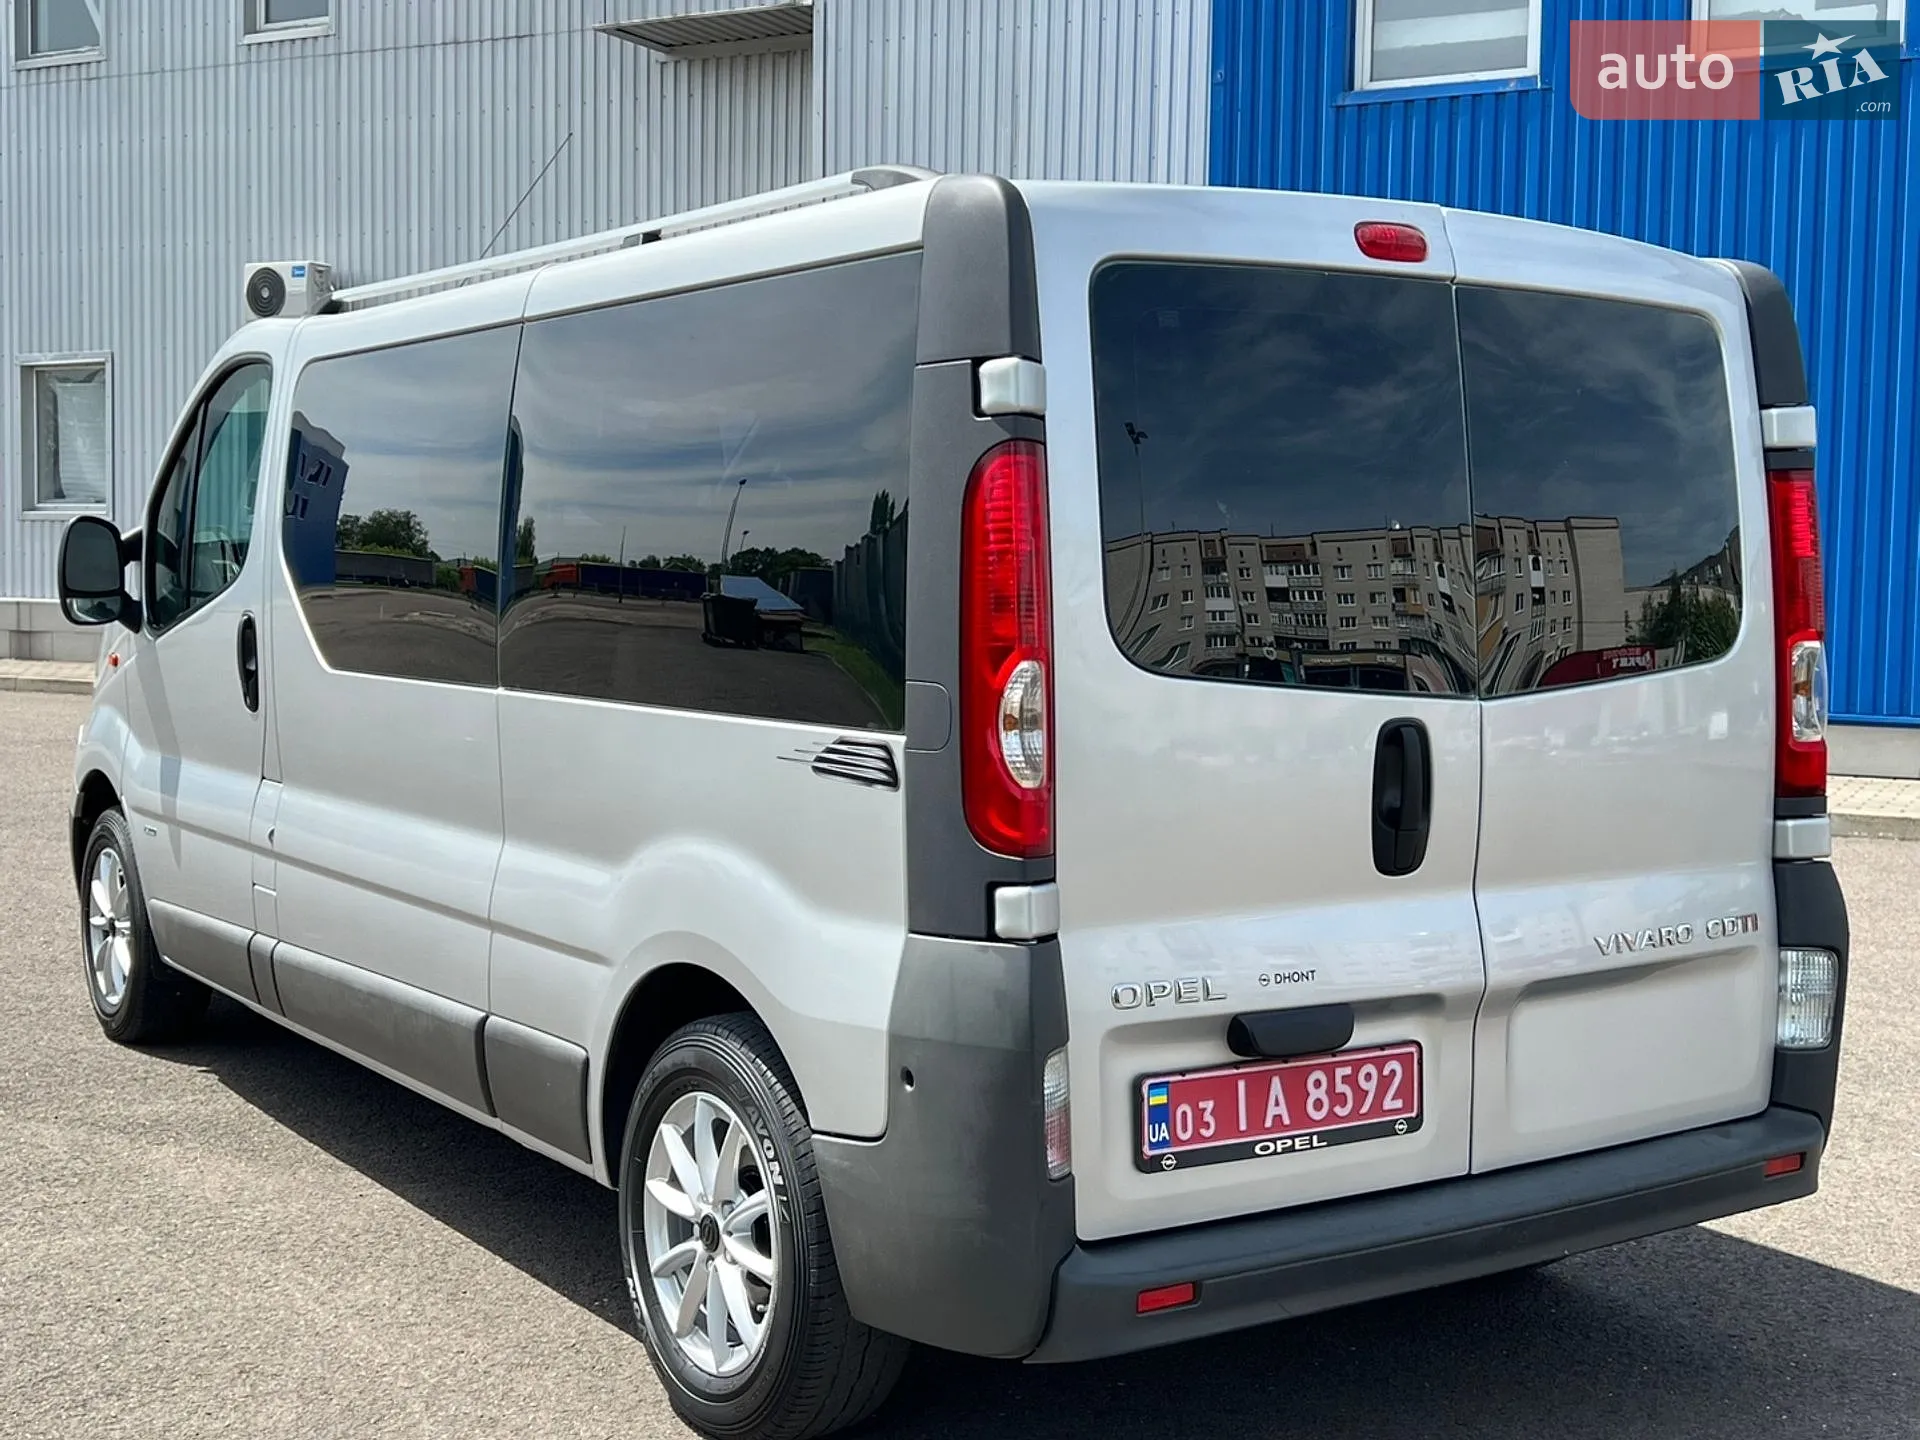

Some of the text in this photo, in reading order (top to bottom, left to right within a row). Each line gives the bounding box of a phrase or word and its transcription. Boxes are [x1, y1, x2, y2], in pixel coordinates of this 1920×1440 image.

[1593, 913, 1759, 956] VIVARO CDTI
[1111, 976, 1228, 1010] OPEL
[1273, 969, 1317, 985] DHONT
[1174, 1099, 1217, 1142] 03
[1305, 1059, 1404, 1122] 8592
[744, 1105, 785, 1186] AVON
[1149, 1121, 1170, 1143] UA
[1253, 1134, 1328, 1156] OPEL
